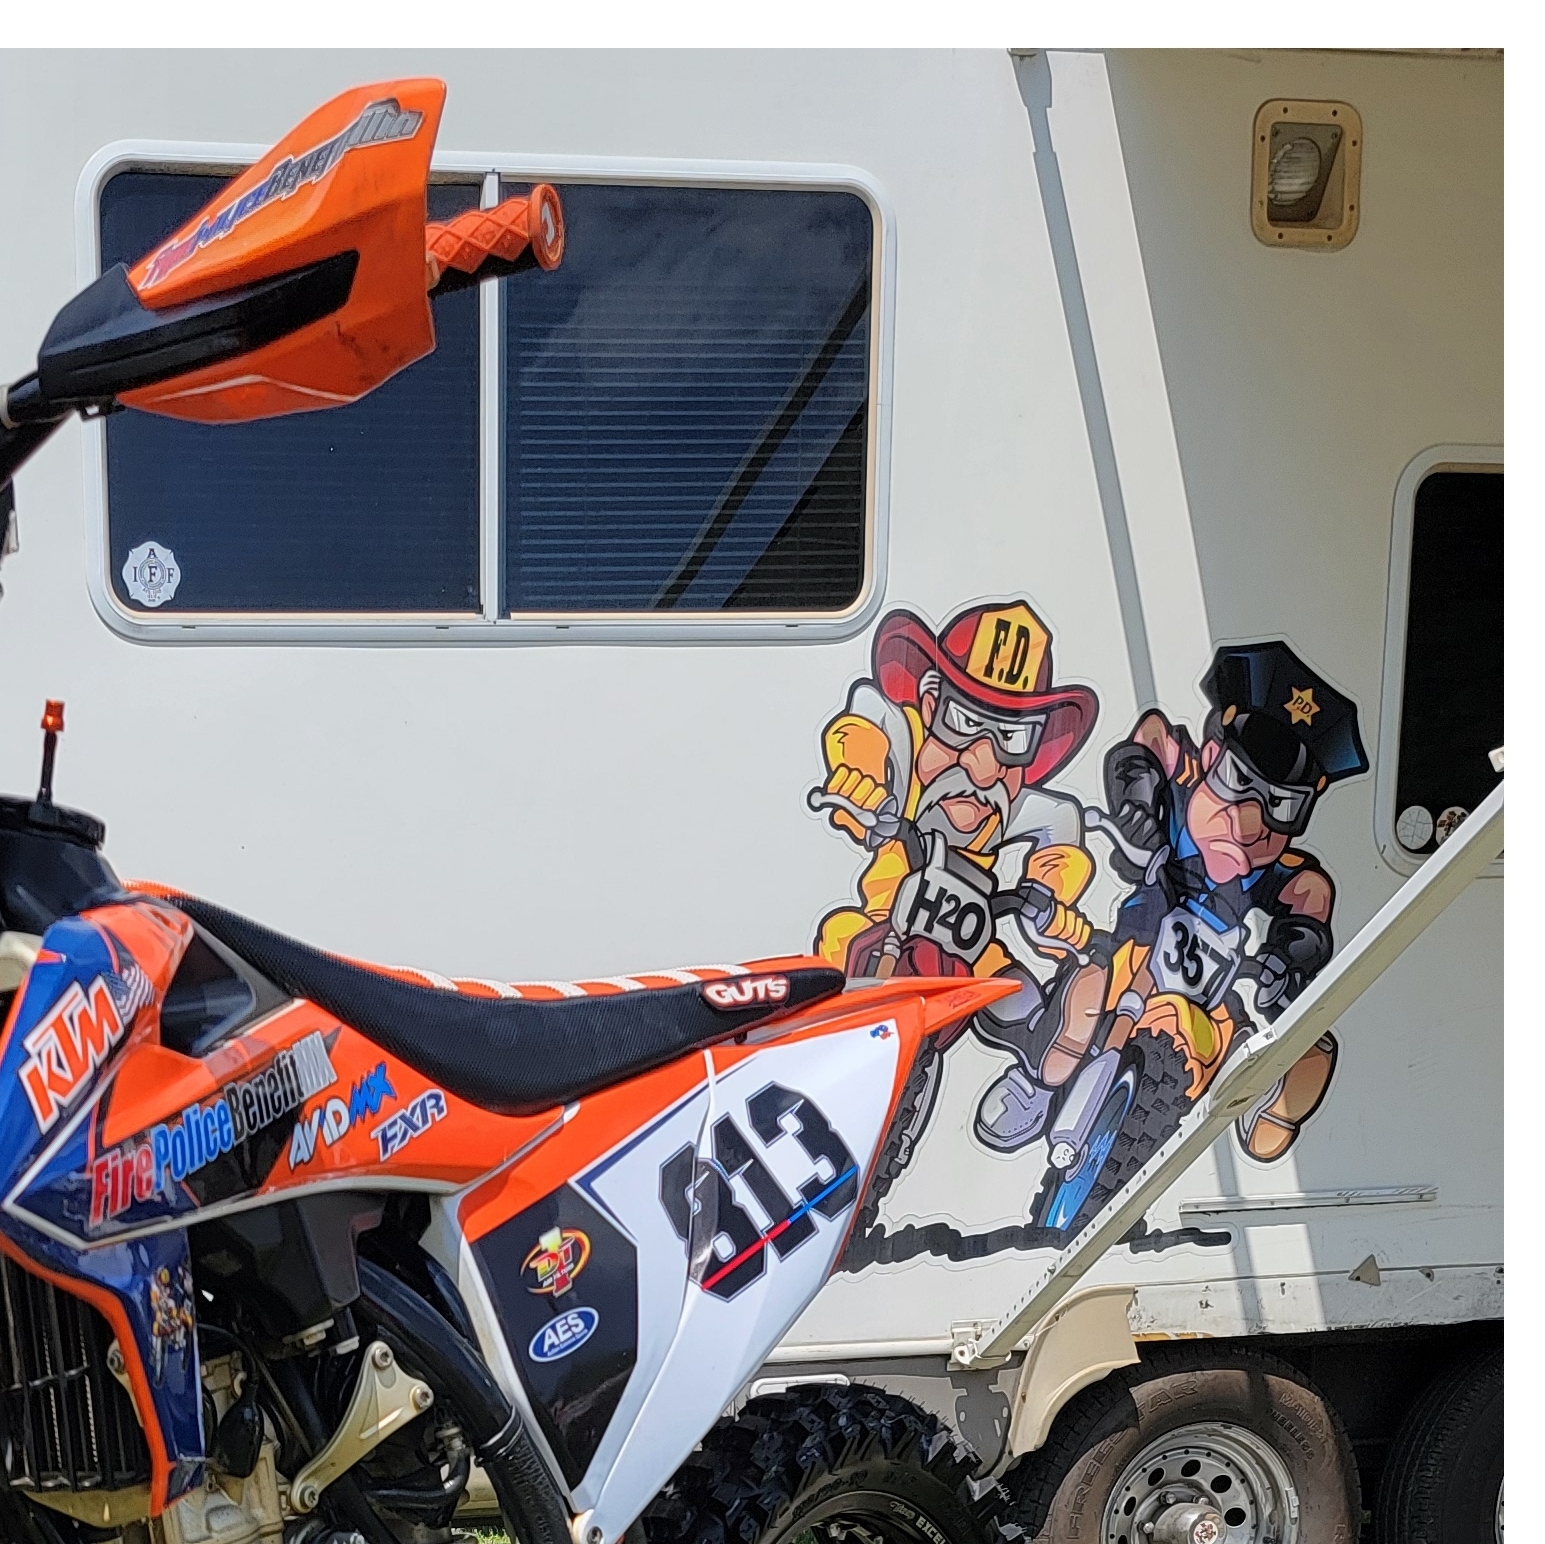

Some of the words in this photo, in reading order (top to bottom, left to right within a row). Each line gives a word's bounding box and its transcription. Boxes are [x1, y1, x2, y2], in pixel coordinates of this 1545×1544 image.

[982, 617, 1030, 690] F.D.
[1291, 695, 1313, 718] P.D.
[904, 878, 987, 951] H2O
[704, 977, 788, 1005] GUTS
[17, 974, 125, 1135] KTM
[369, 1088, 448, 1163] FXR
[657, 1079, 860, 1304] 813
[542, 1312, 586, 1354] AES
